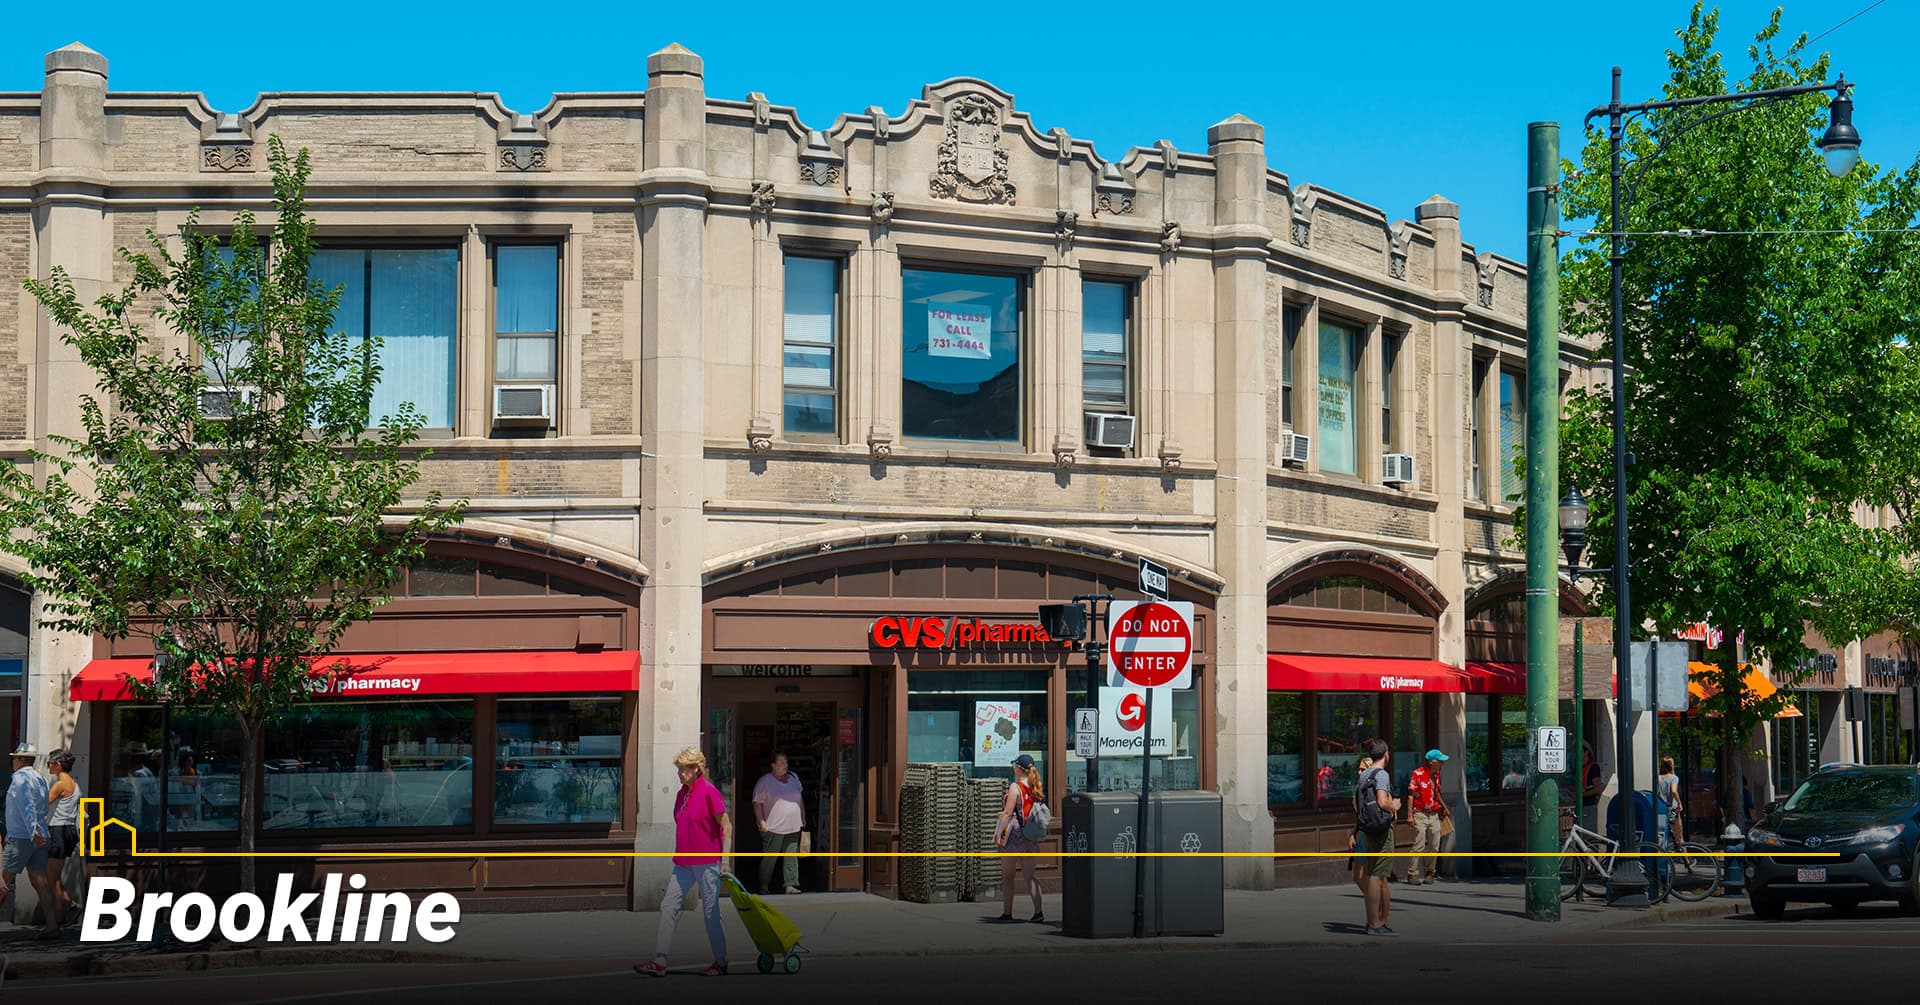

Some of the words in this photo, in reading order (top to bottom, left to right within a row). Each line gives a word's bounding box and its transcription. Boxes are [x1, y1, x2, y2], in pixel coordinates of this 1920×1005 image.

[932, 310, 952, 320] FOR
[957, 312, 986, 323] LEASE
[946, 324, 972, 336] CALL
[933, 338, 985, 351] 731-4444
[1147, 571, 1156, 586] ONE
[1156, 575, 1165, 590] WAY
[871, 616, 1071, 648] CVS/pharma
[1122, 619, 1143, 633] DO
[1149, 619, 1180, 633] NOT
[1124, 656, 1176, 670] ENTER
[741, 664, 812, 677] welcome
[290, 677, 421, 693] VS/pharmacy
